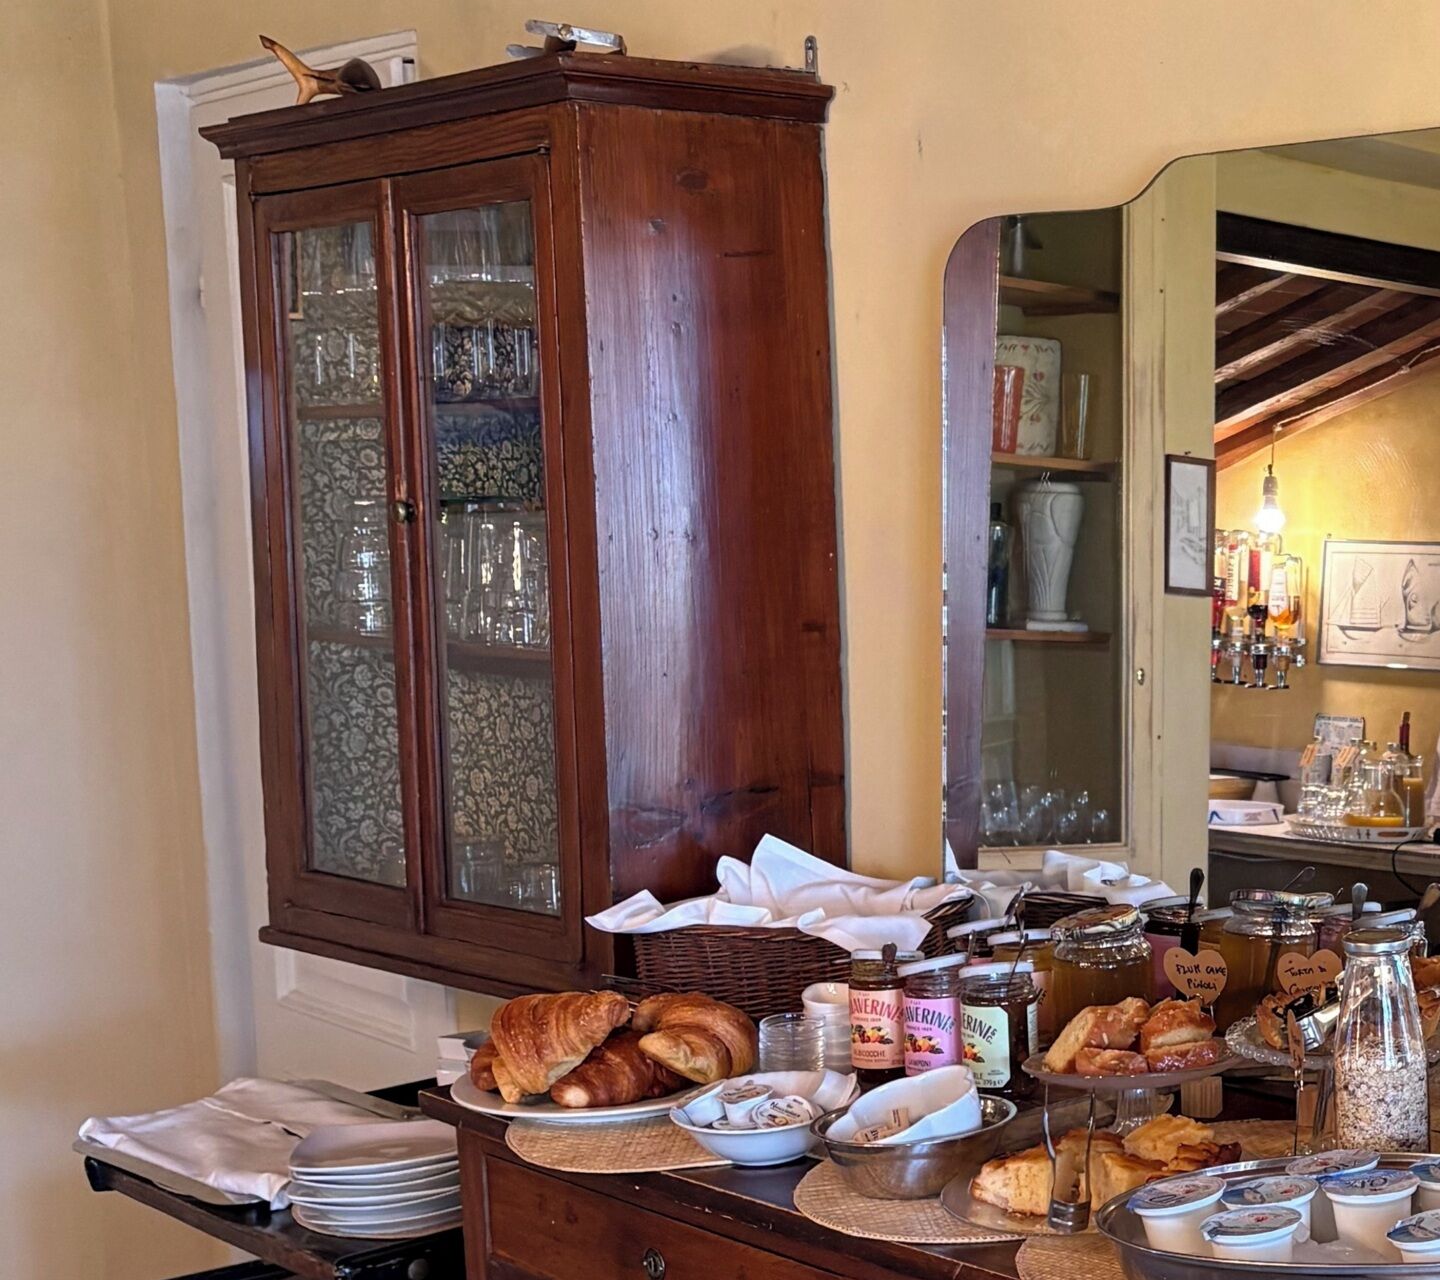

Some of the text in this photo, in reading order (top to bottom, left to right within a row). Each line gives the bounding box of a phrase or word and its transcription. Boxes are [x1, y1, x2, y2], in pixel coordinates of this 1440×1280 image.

[849, 997, 902, 1022] AVERINI
[904, 1005, 952, 1030] AVERINI
[962, 1012, 993, 1040] ERINI
